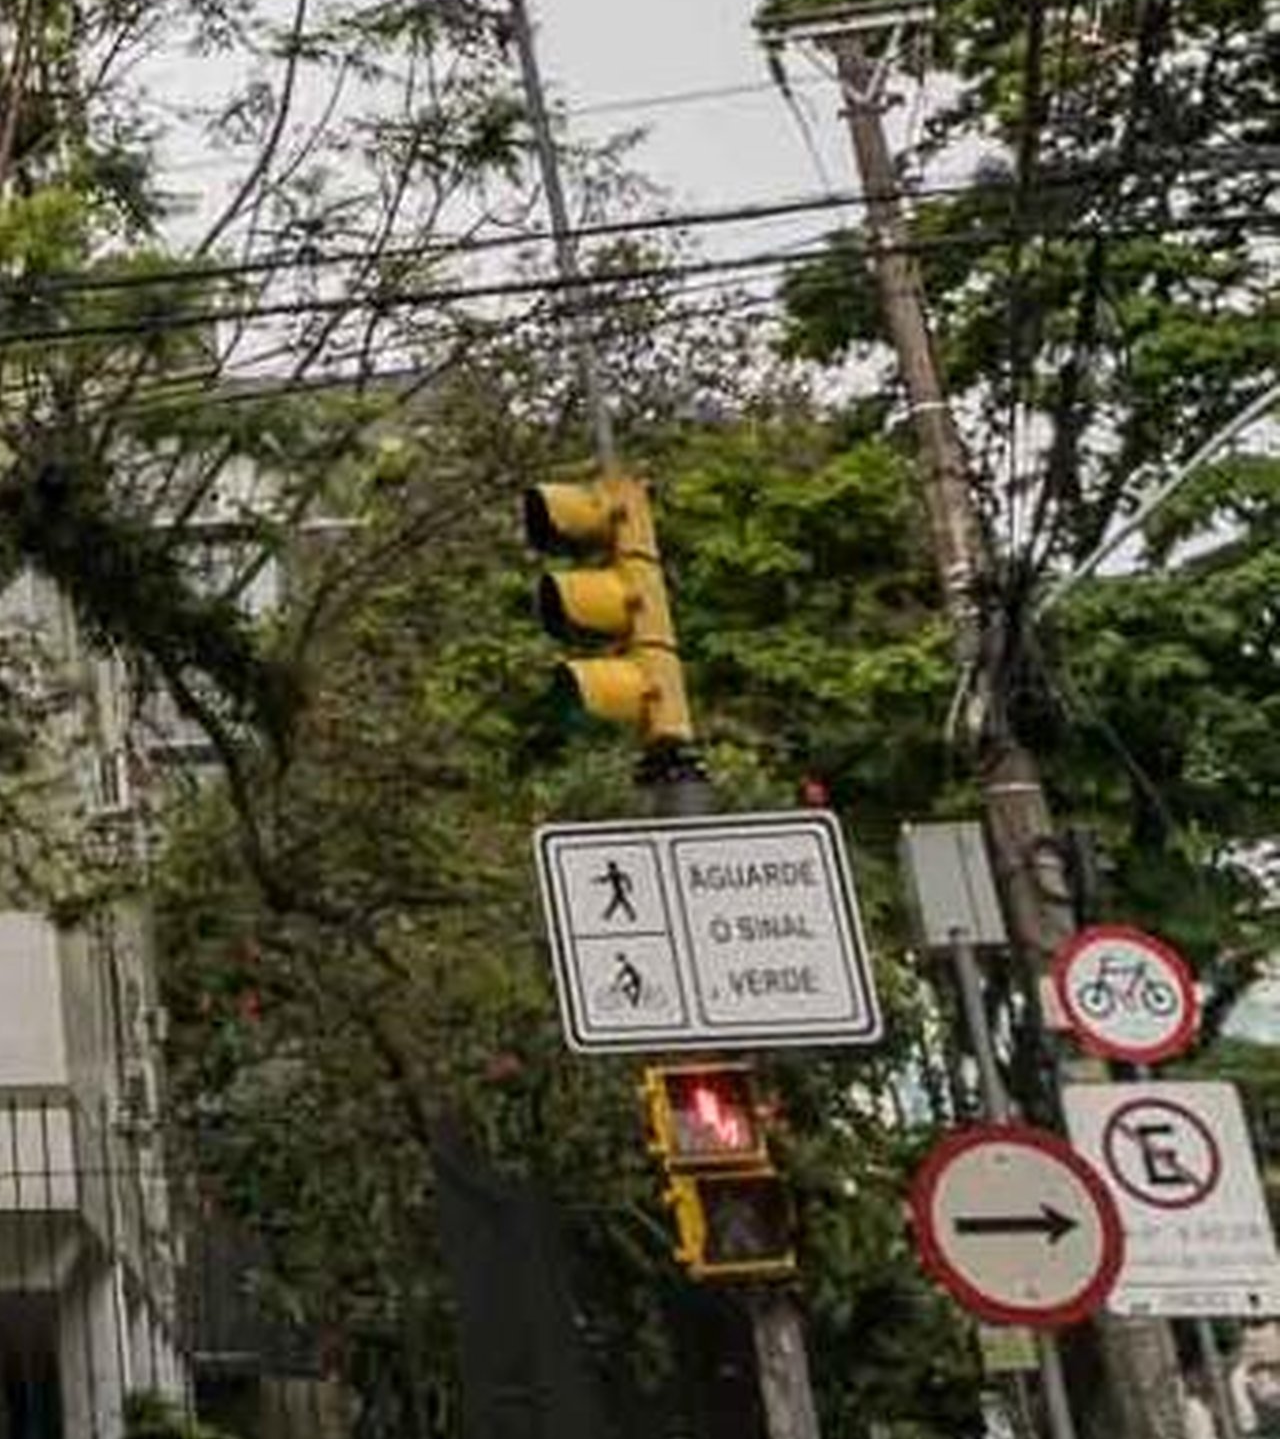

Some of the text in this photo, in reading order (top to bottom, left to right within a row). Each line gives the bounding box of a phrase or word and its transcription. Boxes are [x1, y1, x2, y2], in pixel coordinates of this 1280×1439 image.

[690, 861, 818, 890] AGUARDE
[709, 915, 814, 943] O SINAL
[727, 966, 820, 996] VERDE
[1137, 1124, 1192, 1185] E
